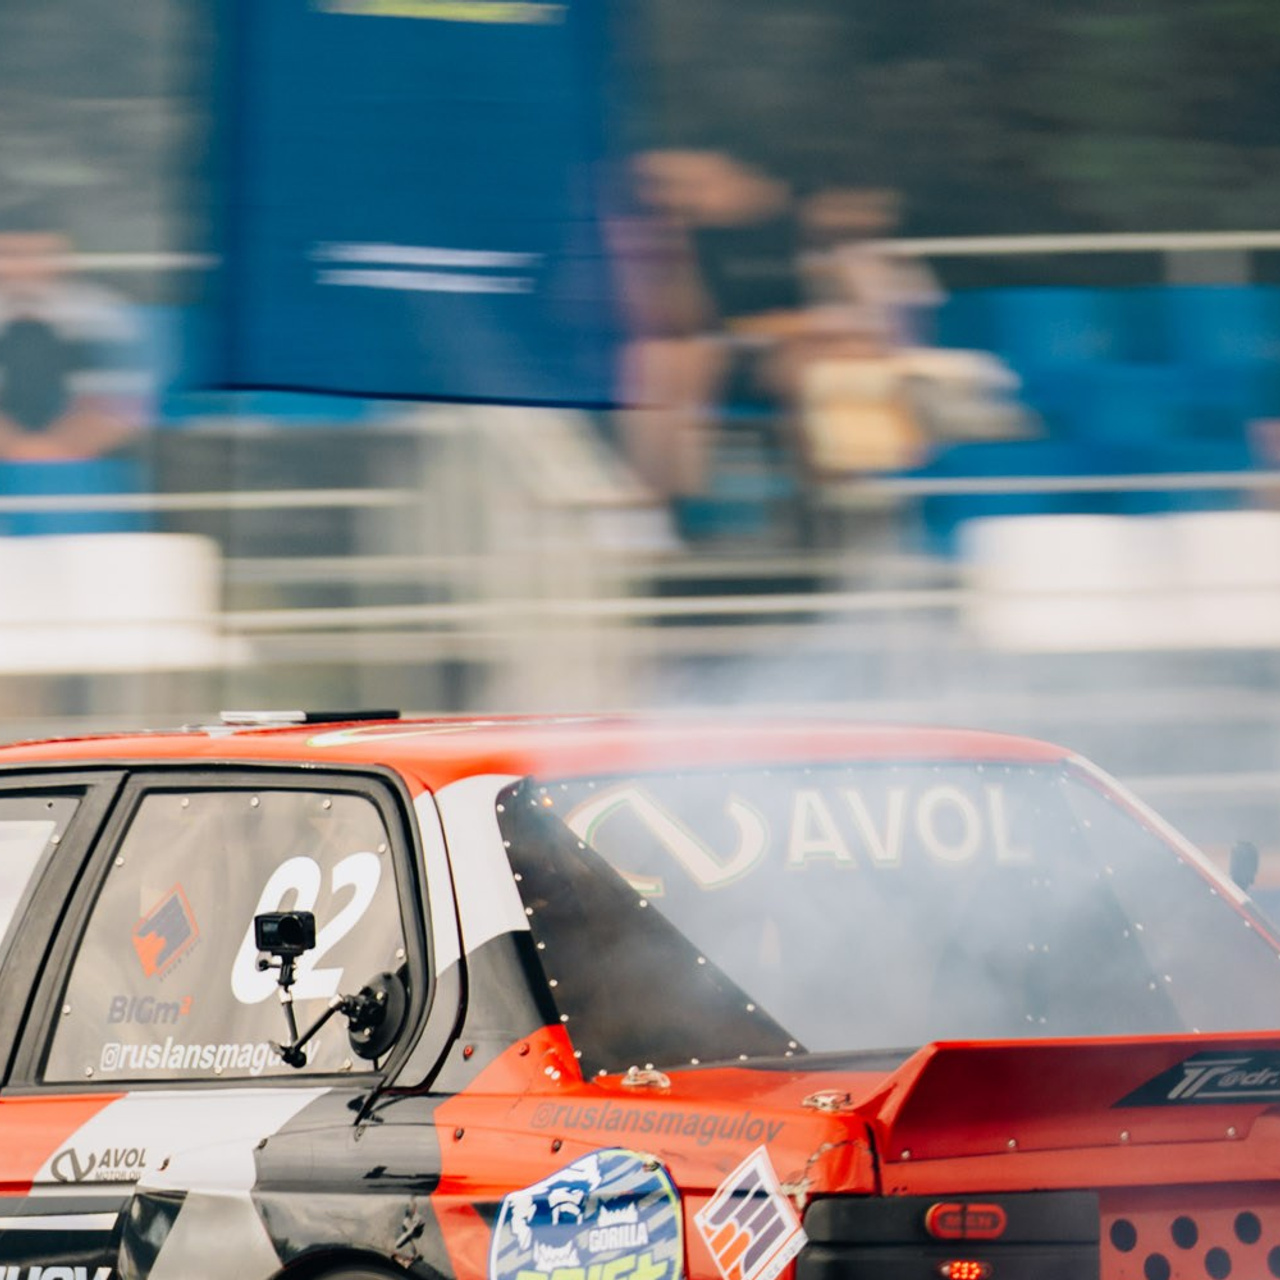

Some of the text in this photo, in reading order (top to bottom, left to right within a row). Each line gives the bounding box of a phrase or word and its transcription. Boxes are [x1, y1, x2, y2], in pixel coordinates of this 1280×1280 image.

[785, 785, 1033, 870] AVOL
[231, 852, 382, 1004] 02
[98, 1148, 146, 1168] AVOL
[589, 1222, 649, 1252] GORILLA
